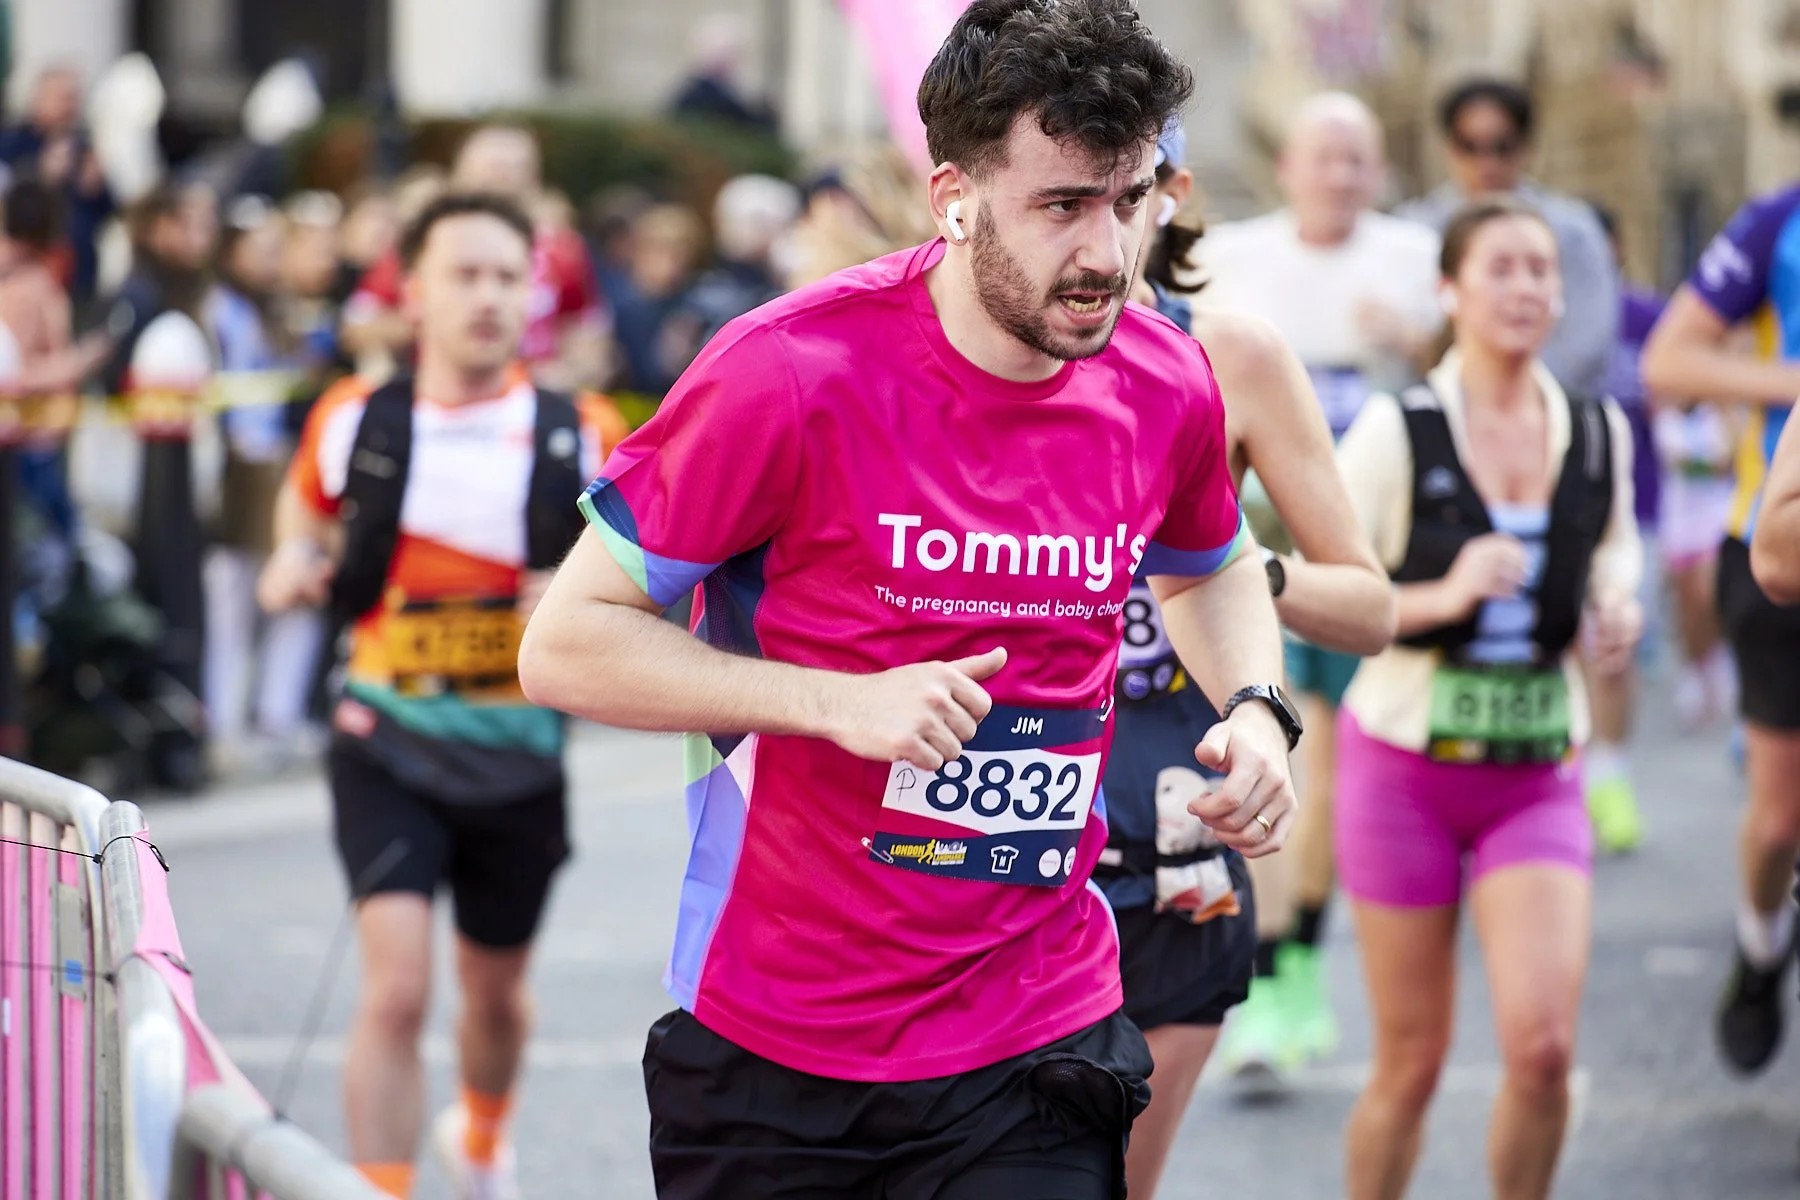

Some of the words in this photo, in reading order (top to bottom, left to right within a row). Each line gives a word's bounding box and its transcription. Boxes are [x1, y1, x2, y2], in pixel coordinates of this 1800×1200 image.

[878, 512, 1147, 592] Tommy's
[874, 585, 907, 608] The
[911, 596, 1011, 618] pregnancy
[1016, 598, 1051, 616] and
[1054, 599, 1095, 620] baby
[1010, 716, 1044, 736] JIM
[925, 753, 1082, 822] 8832
[889, 844, 926, 858] LONDON
